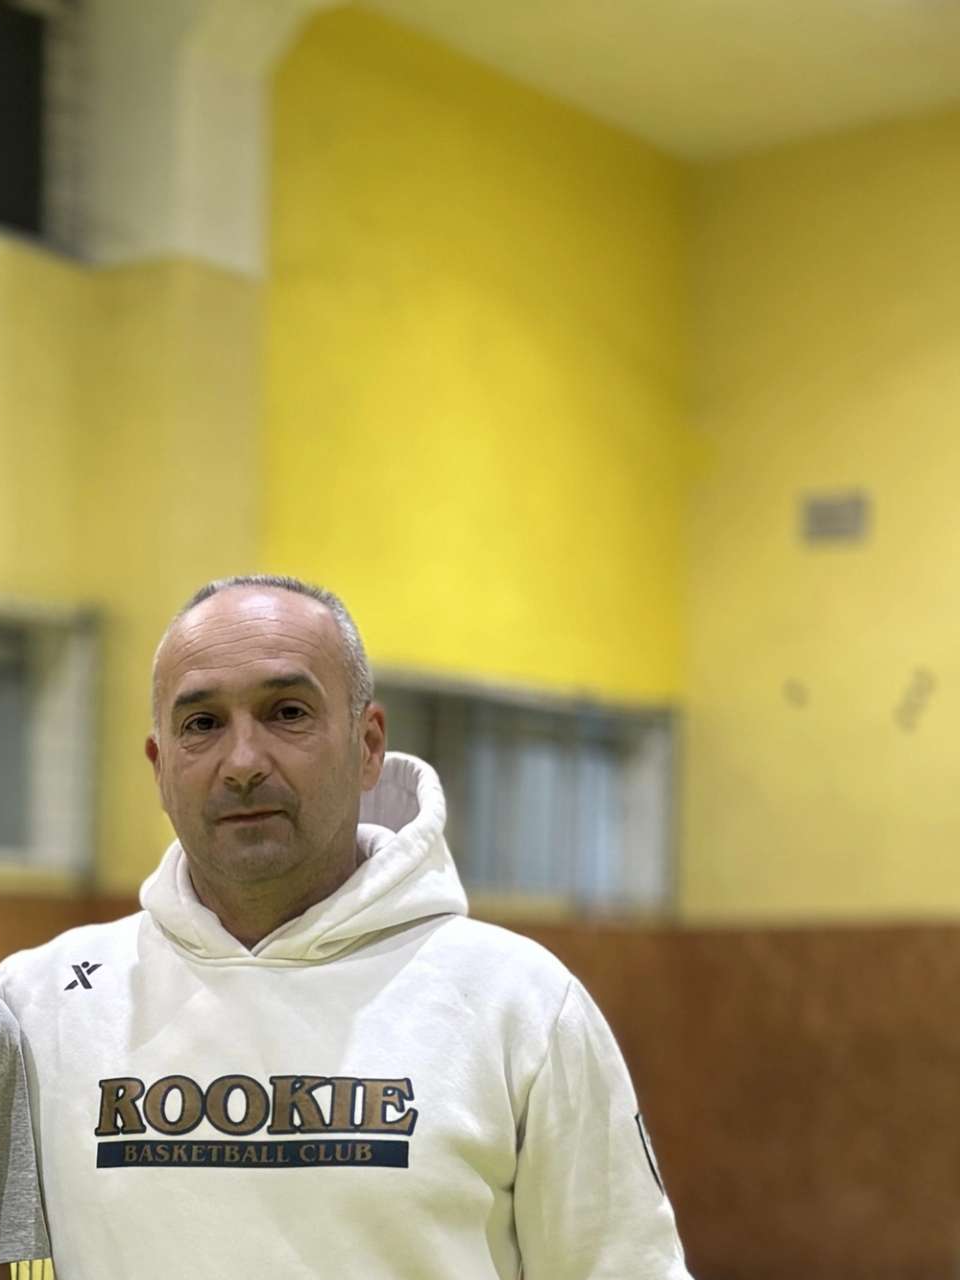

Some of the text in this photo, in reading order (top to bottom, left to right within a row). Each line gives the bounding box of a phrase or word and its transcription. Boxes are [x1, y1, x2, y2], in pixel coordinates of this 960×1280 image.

[94, 1074, 419, 1136] ROOKIE
[124, 1143, 373, 1163] BASKETBALL CLUB
